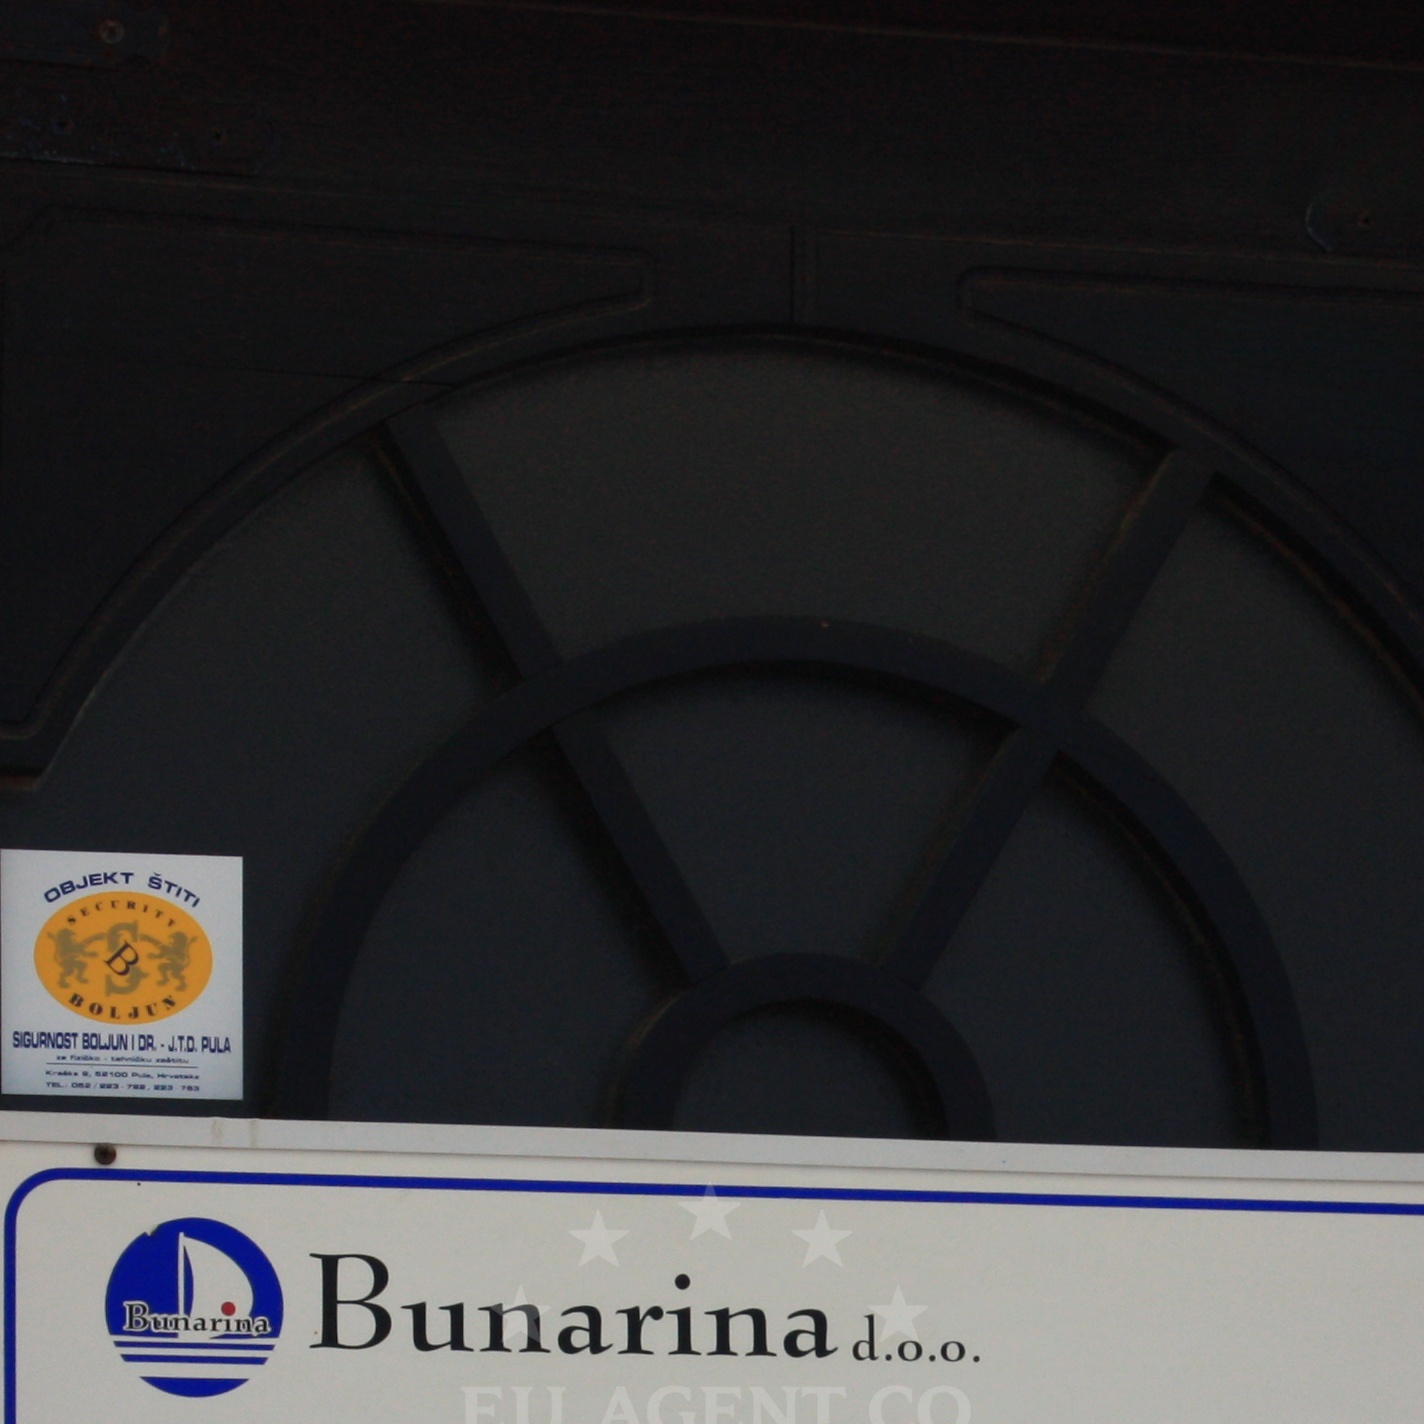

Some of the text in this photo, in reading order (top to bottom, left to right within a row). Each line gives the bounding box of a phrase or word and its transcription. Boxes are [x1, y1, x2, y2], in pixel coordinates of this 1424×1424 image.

[43, 871, 201, 908] OBJEKT ŠTITI
[67, 900, 176, 927] SECURITY
[69, 993, 176, 1020] BOLJUN
[12, 1030, 78, 1049] SIGURNOST
[82, 1032, 127, 1050] BOLJUN
[138, 1034, 156, 1051] DR.
[168, 1035, 198, 1053] J.T.D.
[201, 1036, 231, 1053] PULA
[125, 1302, 271, 1334] Bunarina
[307, 1252, 981, 1364] Bunarina d.o.o.
